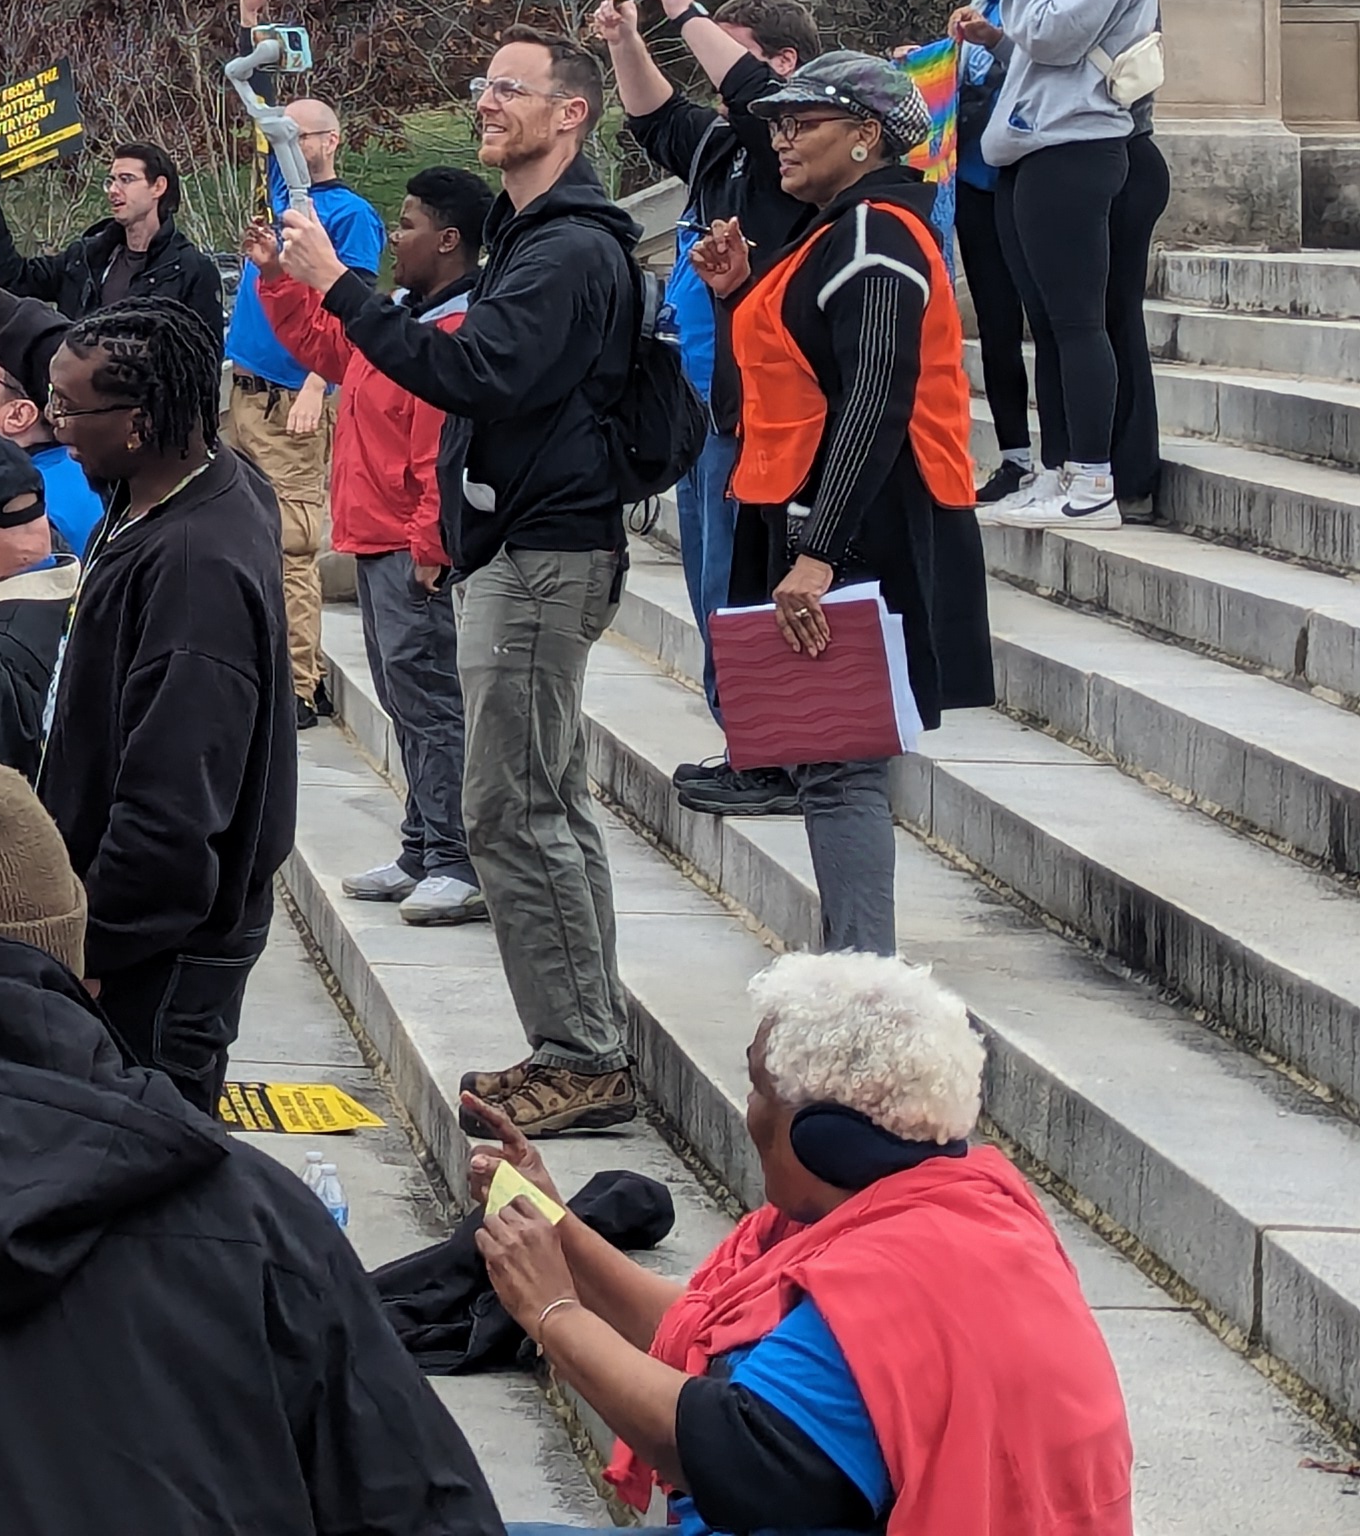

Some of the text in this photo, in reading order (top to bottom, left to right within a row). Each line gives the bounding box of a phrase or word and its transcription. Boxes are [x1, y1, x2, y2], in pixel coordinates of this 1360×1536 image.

[2, 78, 36, 103] FROM
[36, 66, 59, 87] THE
[7, 123, 40, 148] RISES
